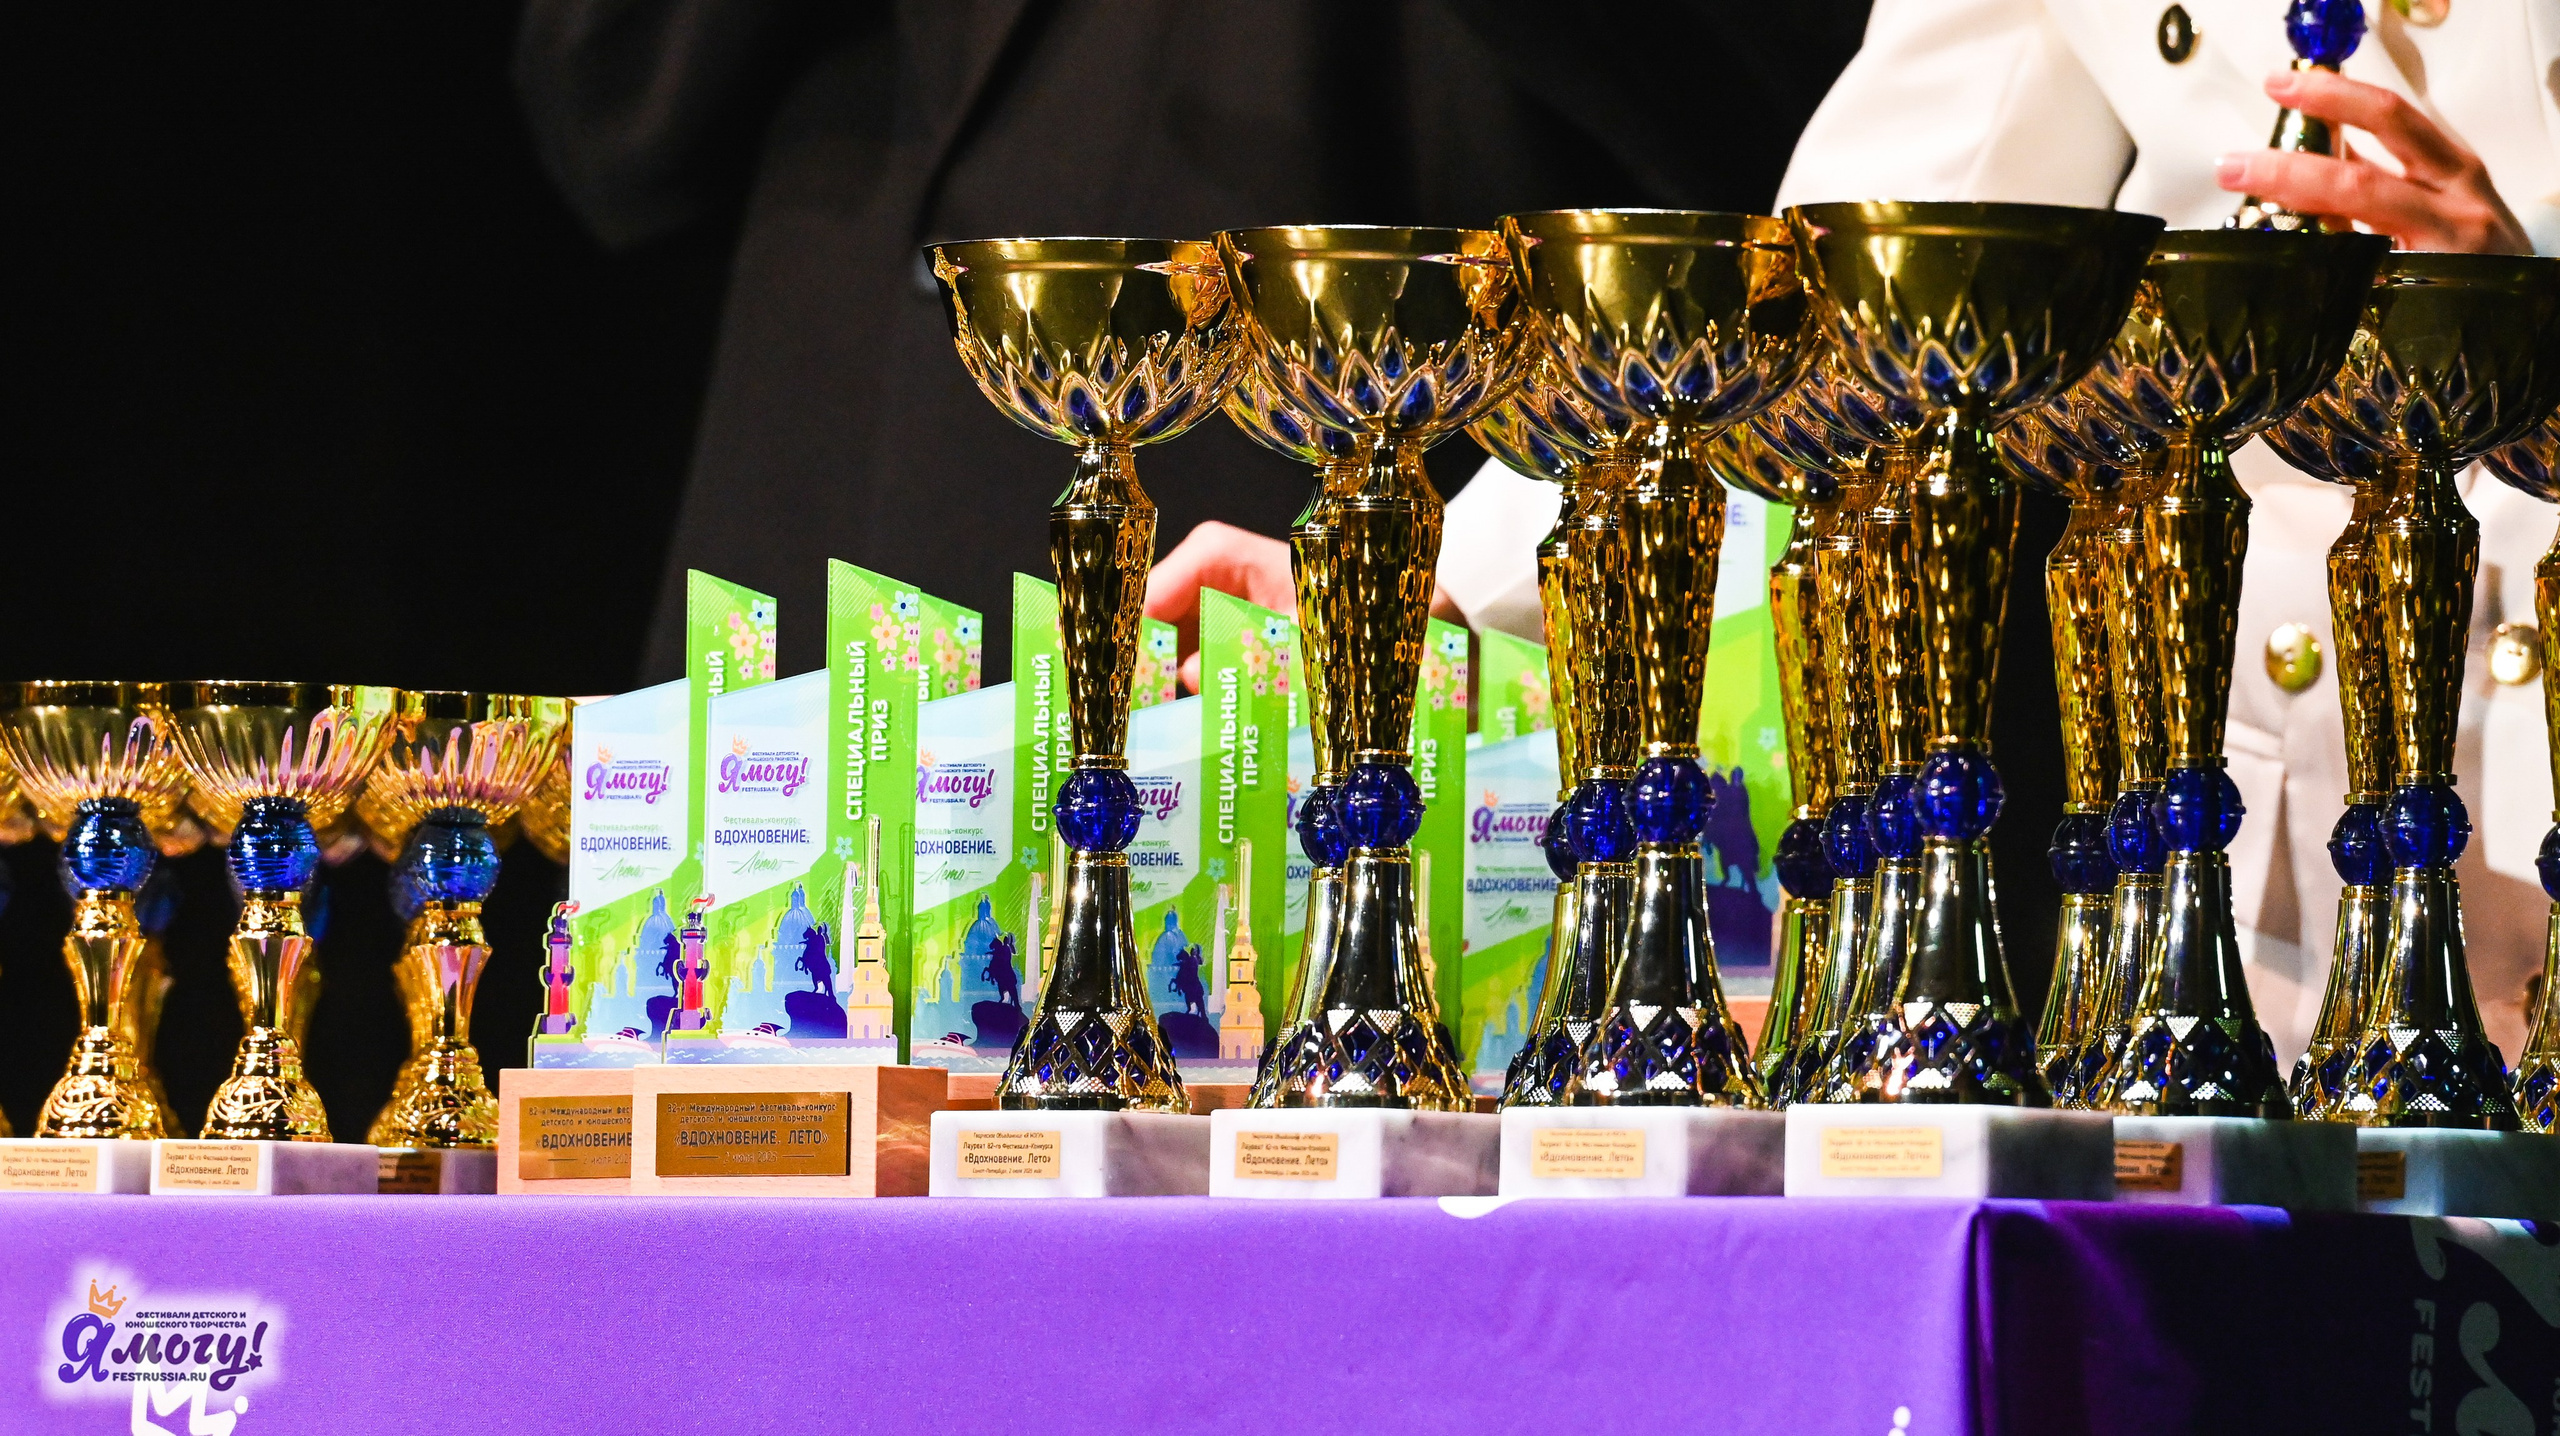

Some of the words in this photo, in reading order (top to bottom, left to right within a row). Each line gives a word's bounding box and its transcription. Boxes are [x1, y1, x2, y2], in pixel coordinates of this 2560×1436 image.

[846, 641, 866, 820] СПЕЦИАЛЬНЫЙ
[871, 699, 888, 761] ПРИЗ
[1032, 654, 1051, 832] СПЕЦИАЛЬНЫЙ
[1056, 712, 1071, 772] ПРИЗ
[718, 753, 743, 793] Я
[741, 757, 808, 797] могу!
[1218, 667, 1238, 844] СПЕЦИАЛЬНЫЙ
[1243, 724, 1259, 785] ПРИЗ
[1420, 738, 1437, 798] ПРИЗ
[584, 763, 607, 800] Я
[606, 765, 669, 804] могу!
[929, 768, 995, 808] могу!
[714, 829, 810, 846] ВДОХНОВЕНИЕ.
[723, 815, 797, 825] Фестиваль-конкурс
[1471, 806, 1494, 843] Я
[1493, 815, 1550, 847] могу
[580, 836, 672, 852] ВДОХНОВЕНИЕ.
[680, 1115, 714, 1124] детского
[727, 1115, 775, 1123] юношеского
[779, 1114, 823, 1123] творчества
[689, 1103, 755, 1116] Международный
[759, 1102, 836, 1114] фестиваль-конкурс
[674, 1130, 781, 1147] «ВДОХНОВЕНИЕ.
[787, 1129, 828, 1145] ЛЕТО»
[964, 1153, 1024, 1164] «Вдохновение.
[1028, 1153, 1051, 1163] Лето»
[614, 1154, 631, 1164] 202
